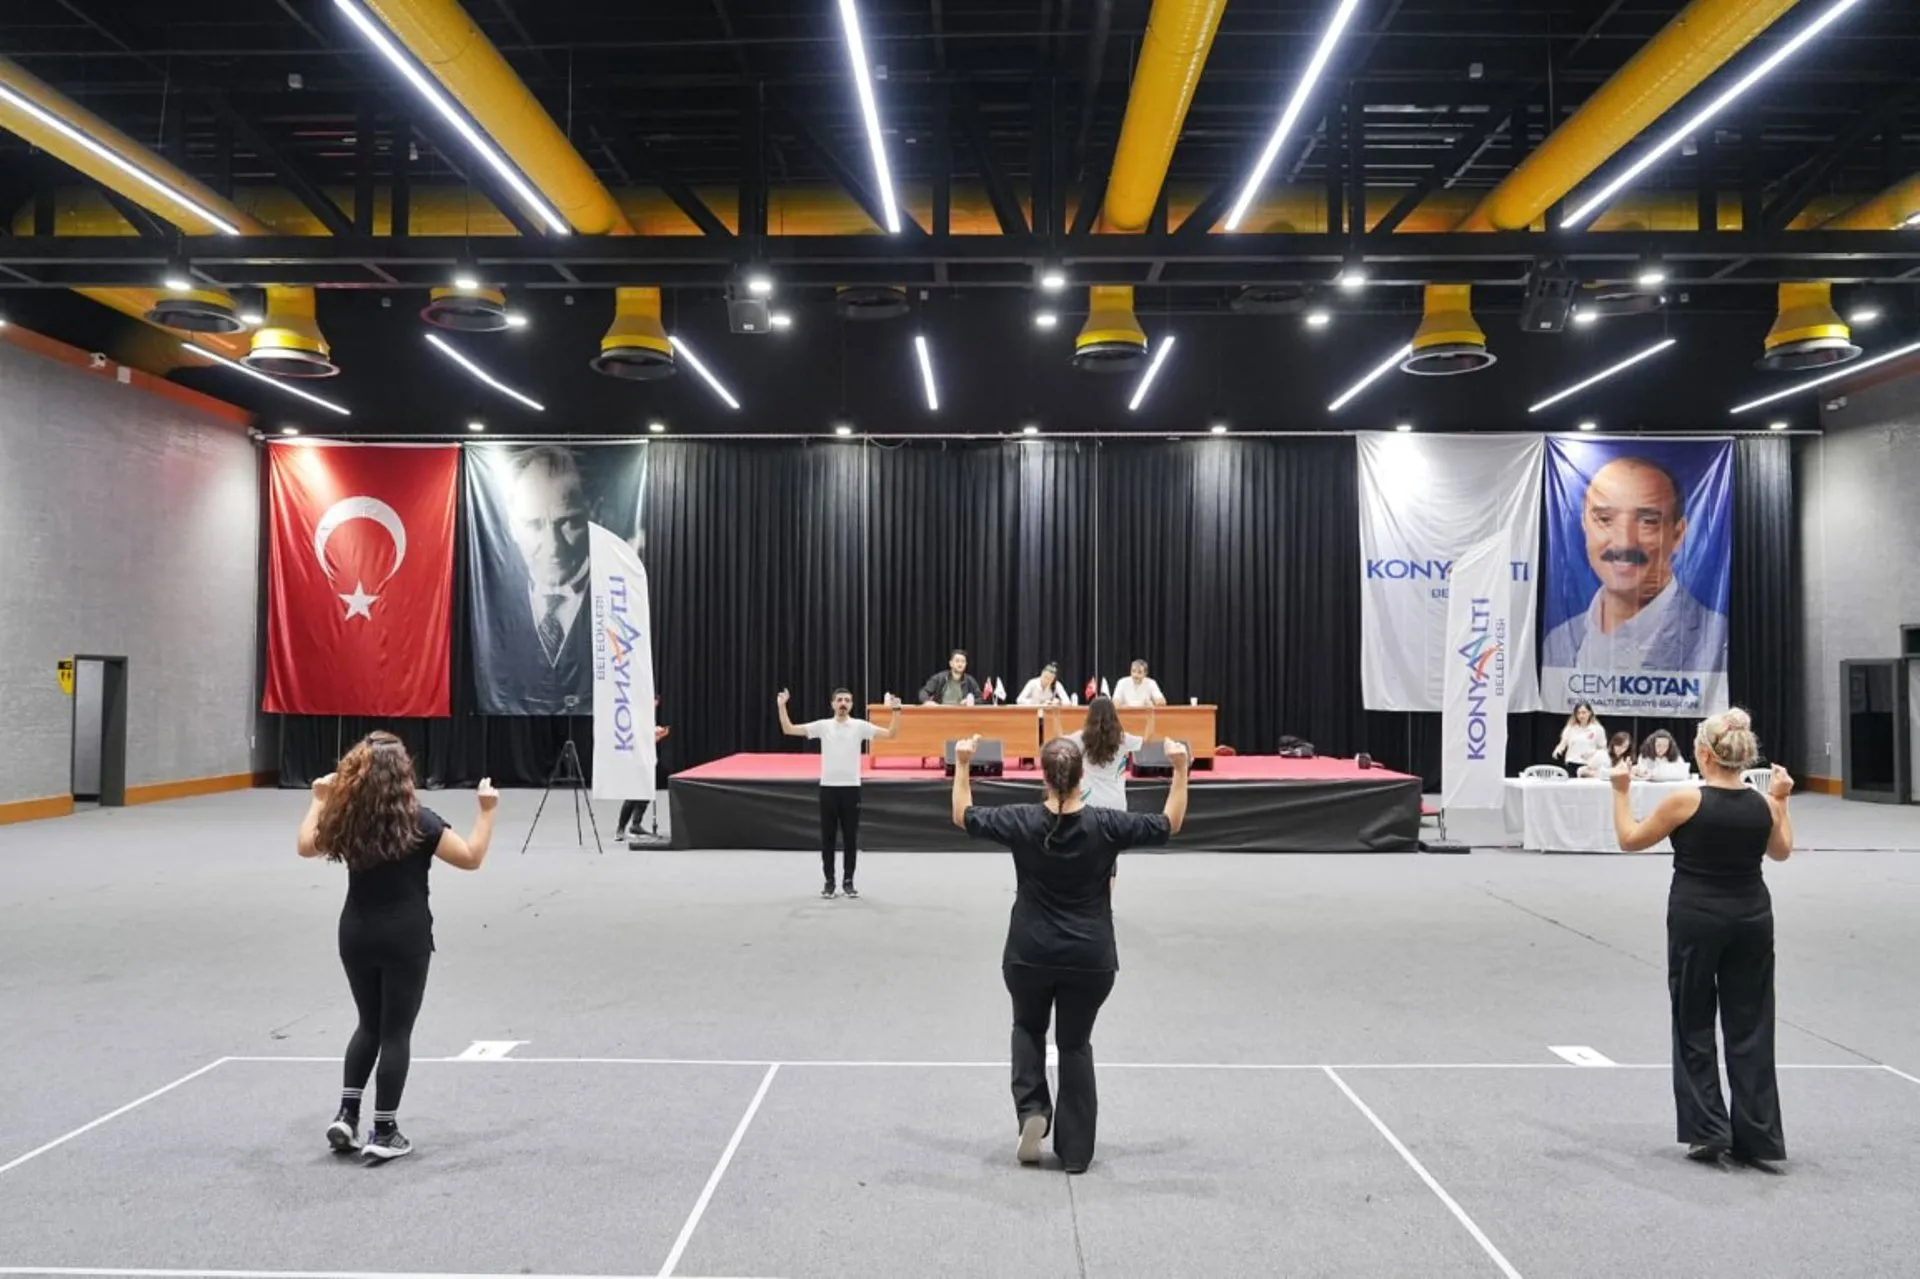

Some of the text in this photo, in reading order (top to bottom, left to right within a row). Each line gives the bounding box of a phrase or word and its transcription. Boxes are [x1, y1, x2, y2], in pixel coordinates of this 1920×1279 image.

[1367, 559, 1529, 582] KONYTI
[1458, 598, 1499, 761] KONYAALTI
[1568, 674, 1700, 696] CEM KOTAN
